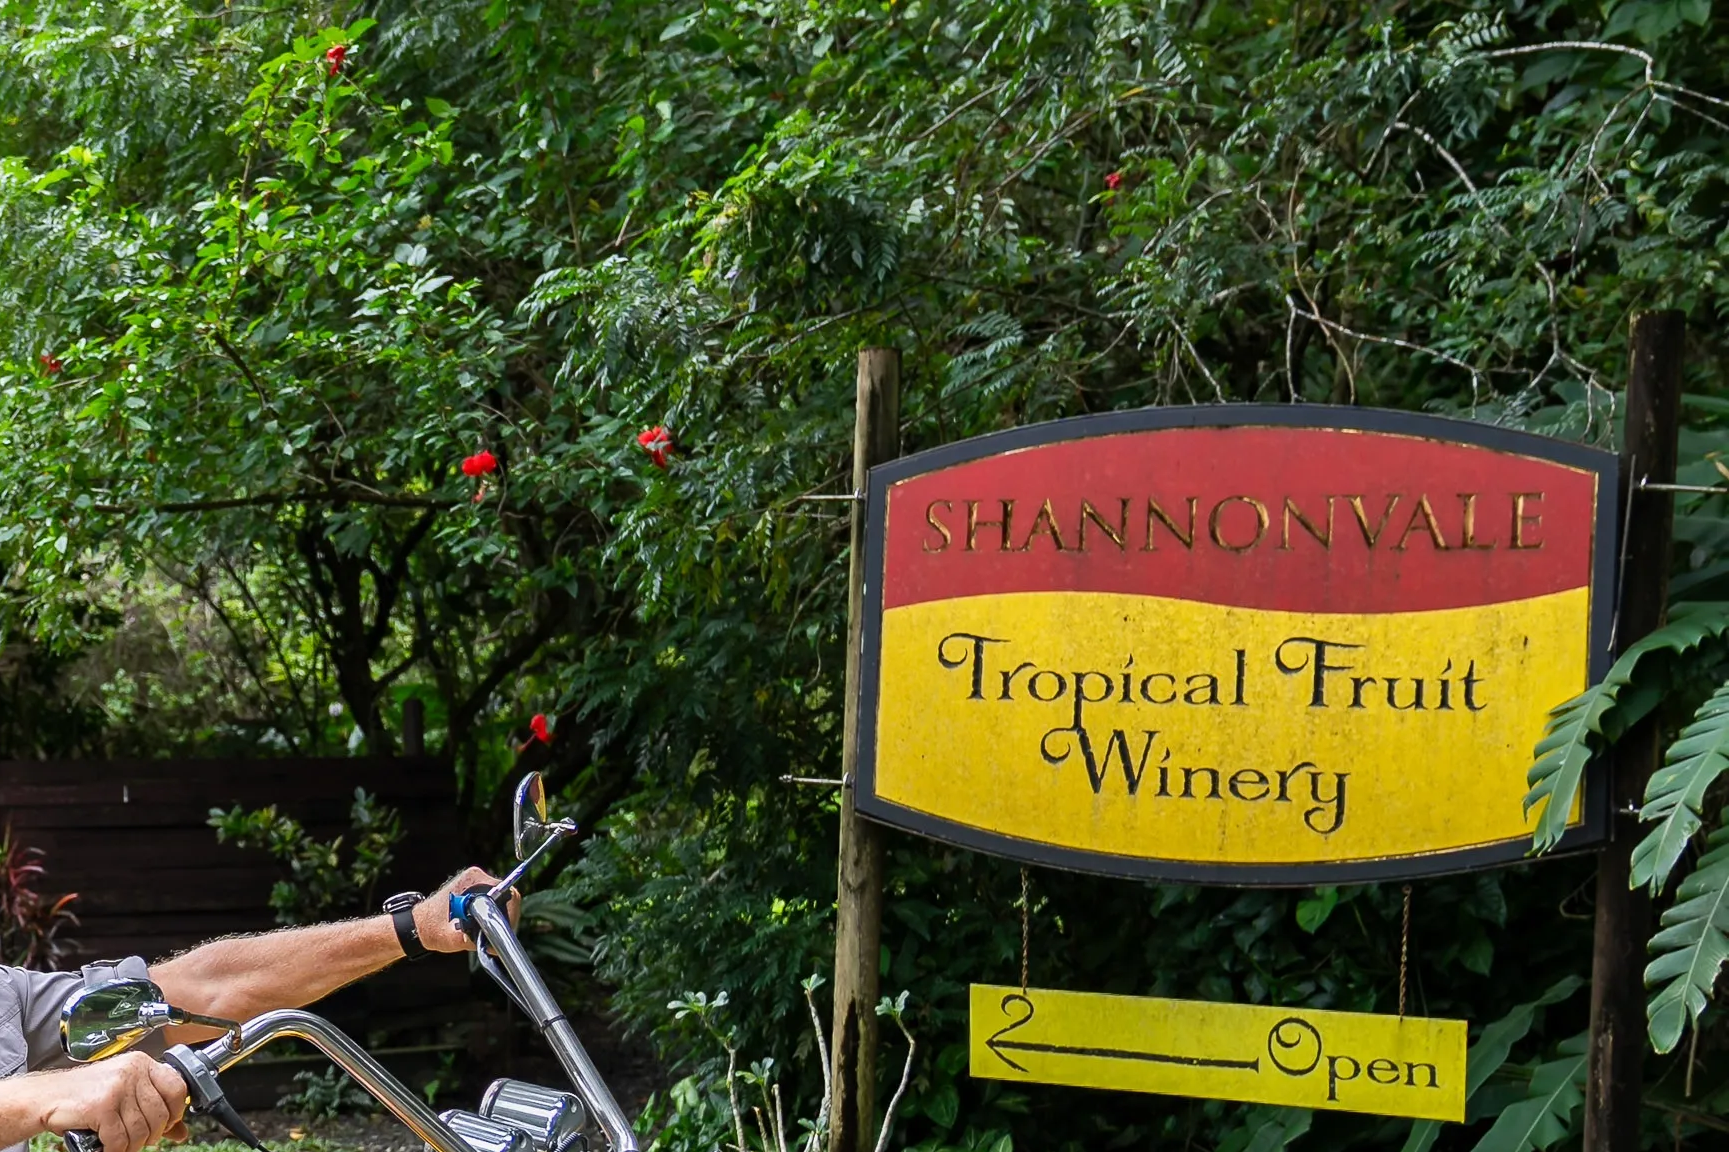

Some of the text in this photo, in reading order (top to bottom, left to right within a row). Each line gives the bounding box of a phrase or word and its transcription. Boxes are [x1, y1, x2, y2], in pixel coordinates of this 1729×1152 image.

[921, 491, 1547, 555] SHANNONVALE
[937, 632, 1488, 733] Tropical Fruit
[1040, 729, 1353, 835] Winery
[1267, 1017, 1440, 1101] Open
